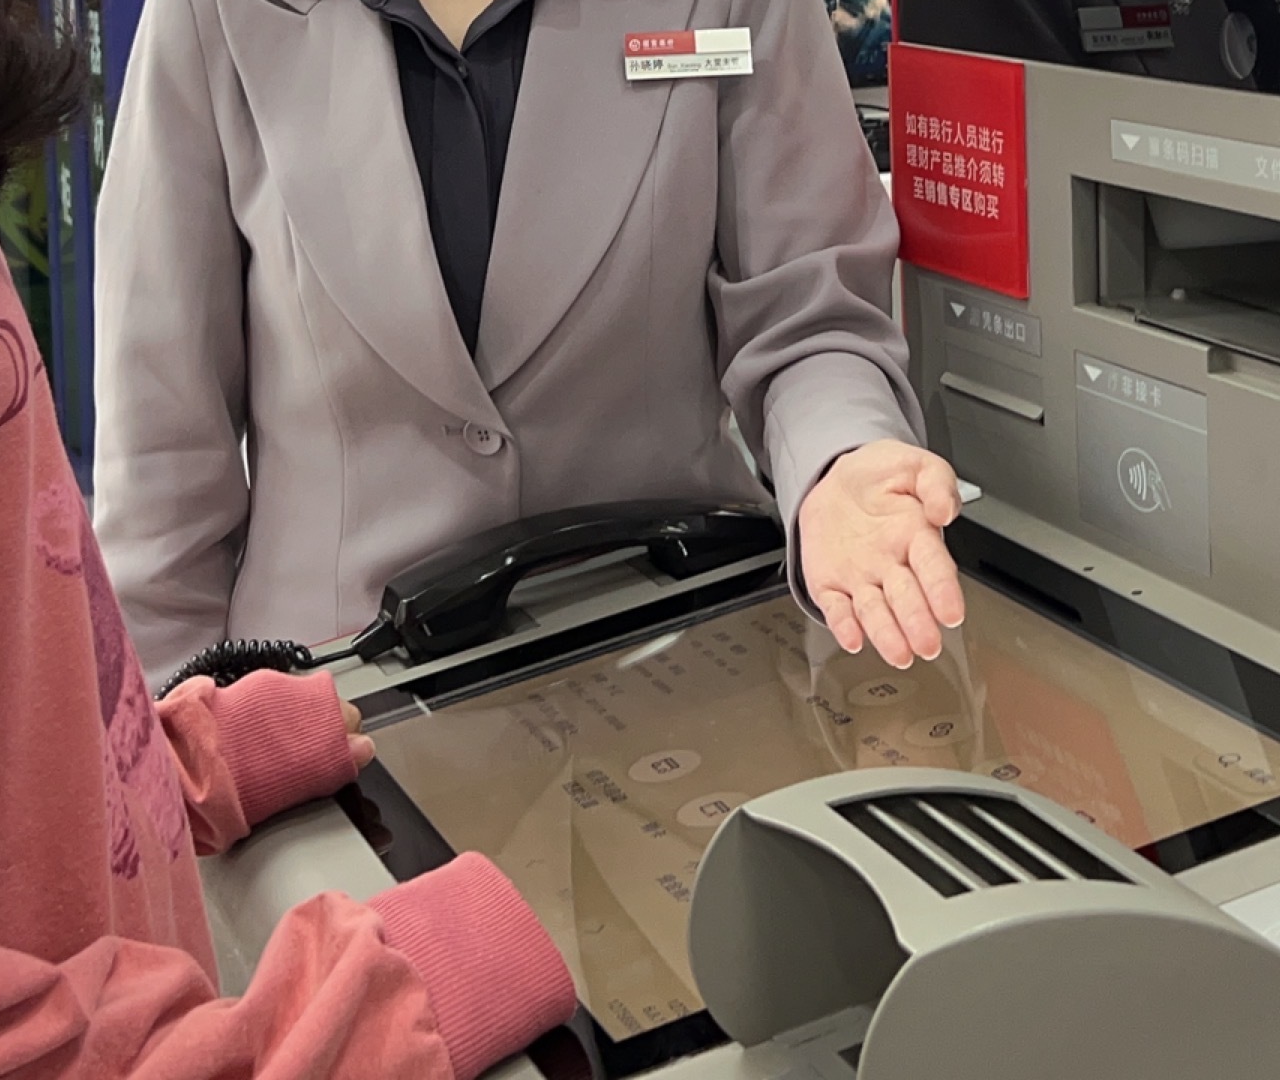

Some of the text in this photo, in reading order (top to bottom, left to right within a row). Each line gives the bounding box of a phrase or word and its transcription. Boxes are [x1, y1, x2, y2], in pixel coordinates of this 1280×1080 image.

[905, 111, 1004, 155] 如有我行人员进行
[906, 143, 1005, 189] 理财产品推介须转
[913, 176, 999, 219] 至销售专区购买
